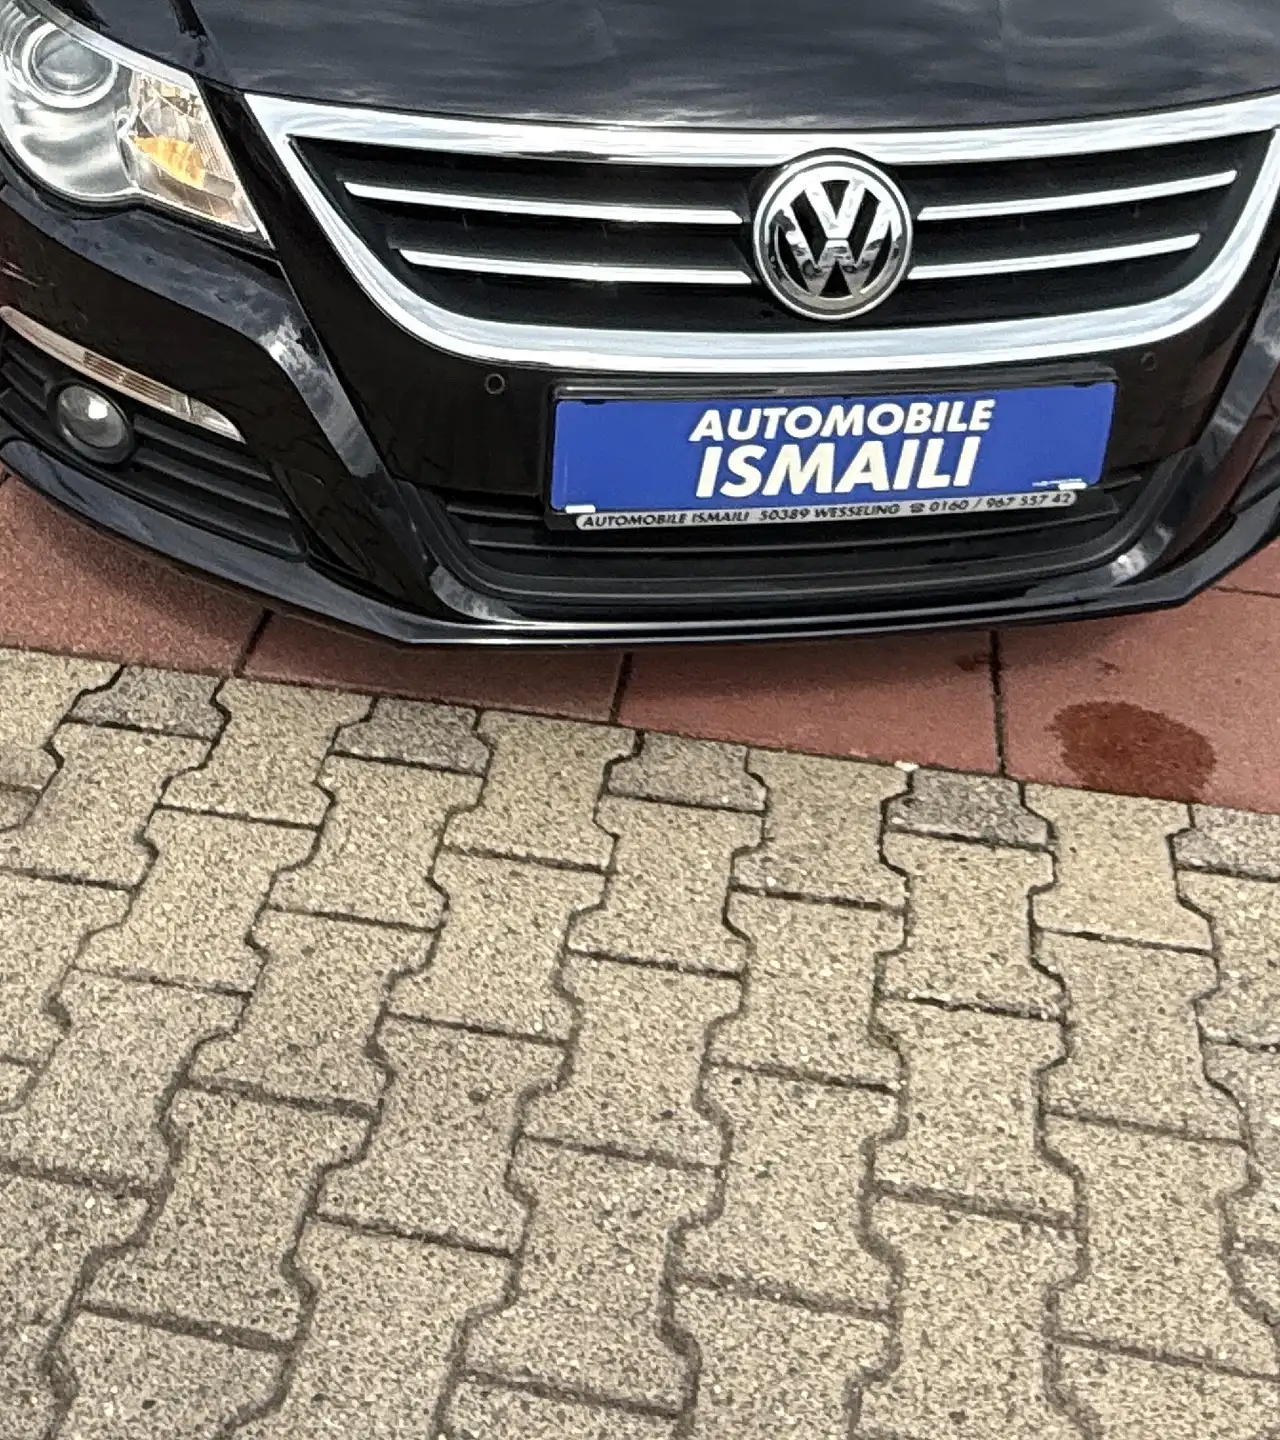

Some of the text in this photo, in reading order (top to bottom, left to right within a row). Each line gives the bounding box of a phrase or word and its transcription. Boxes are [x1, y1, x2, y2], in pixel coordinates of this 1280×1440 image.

[688, 398, 996, 442] AUTOMOBILE
[694, 436, 980, 499] ISMAILI
[582, 513, 688, 527] AUTOMOBILE
[692, 511, 749, 524] ISMAILI
[758, 508, 809, 522] 50389
[813, 503, 901, 518] WESSELING
[929, 499, 969, 512] 0160
